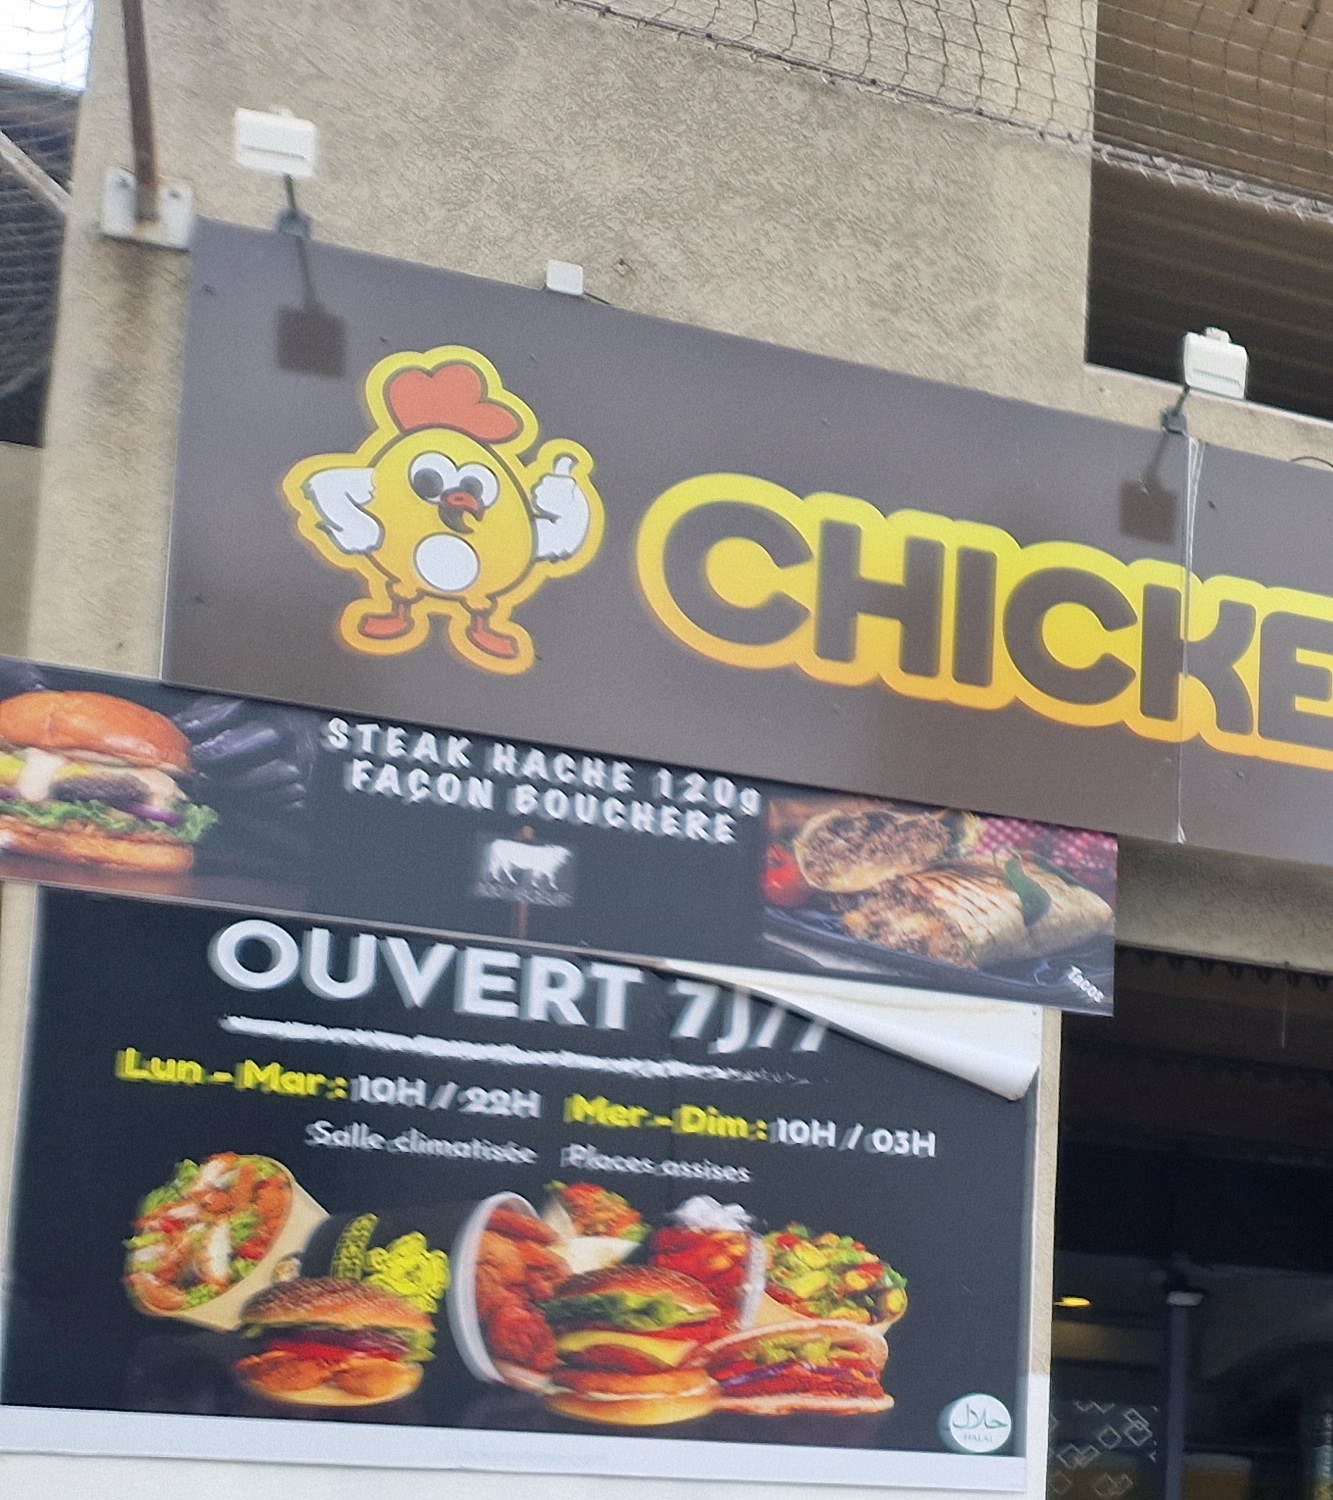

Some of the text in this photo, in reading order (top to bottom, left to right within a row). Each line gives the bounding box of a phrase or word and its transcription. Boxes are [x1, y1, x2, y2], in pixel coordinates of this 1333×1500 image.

[323, 717, 473, 768] STEAK
[347, 758, 495, 811] FAÇON
[209, 919, 644, 1030] OUVERT
[118, 1047, 203, 1084] Lun
[353, 1075, 426, 1107] 10H
[461, 1087, 541, 1119] 22H
[566, 1094, 649, 1128] Mer
[773, 1118, 836, 1147] 10H
[866, 1130, 936, 1158] 03H
[306, 1120, 752, 1184] Salle climatisée Places assises
